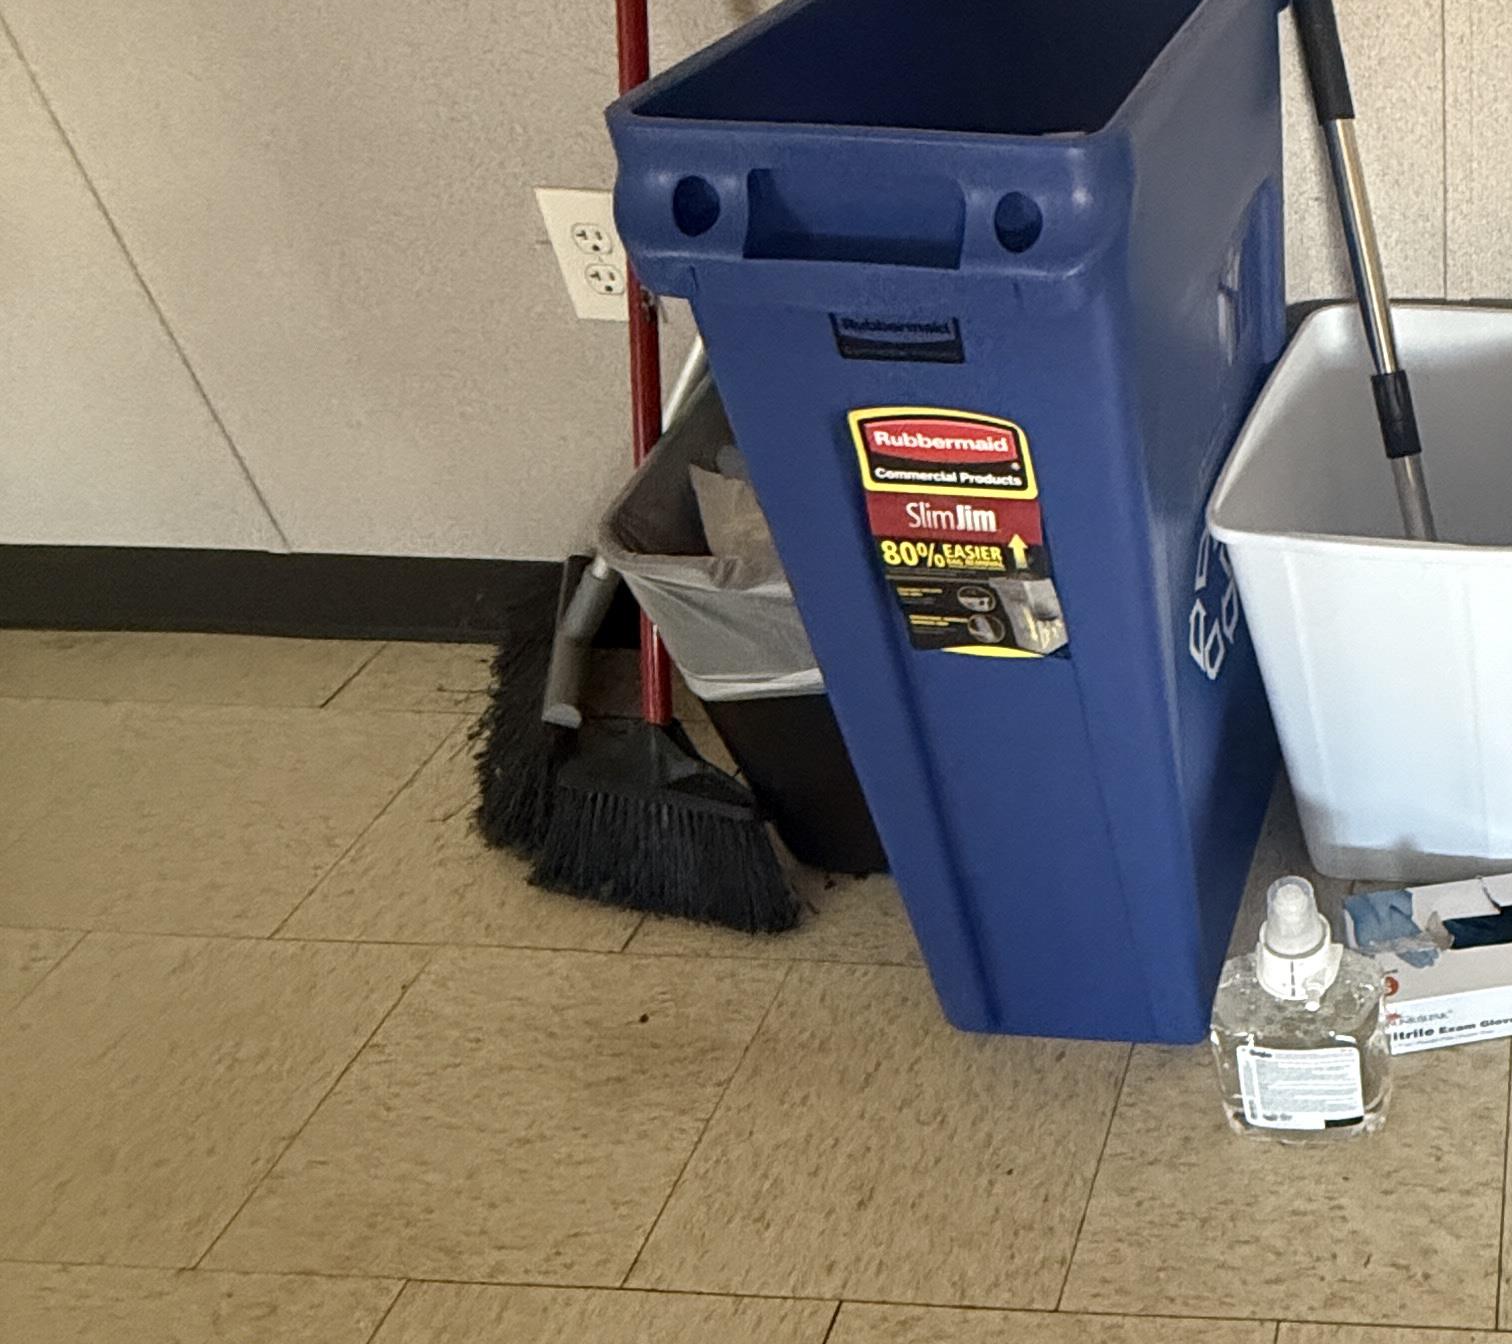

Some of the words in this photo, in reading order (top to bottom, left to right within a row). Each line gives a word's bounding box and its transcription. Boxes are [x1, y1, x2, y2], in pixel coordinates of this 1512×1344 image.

[840, 317, 950, 335] Rubbermaid
[872, 430, 1010, 453] Rubbermaid
[874, 466, 958, 484] Commercial
[959, 471, 1023, 487] Products
[881, 539, 946, 569] 80%
[942, 543, 1003, 561] EASIER
[1393, 1027, 1435, 1041] itrile
[1438, 1023, 1477, 1035] Exam
